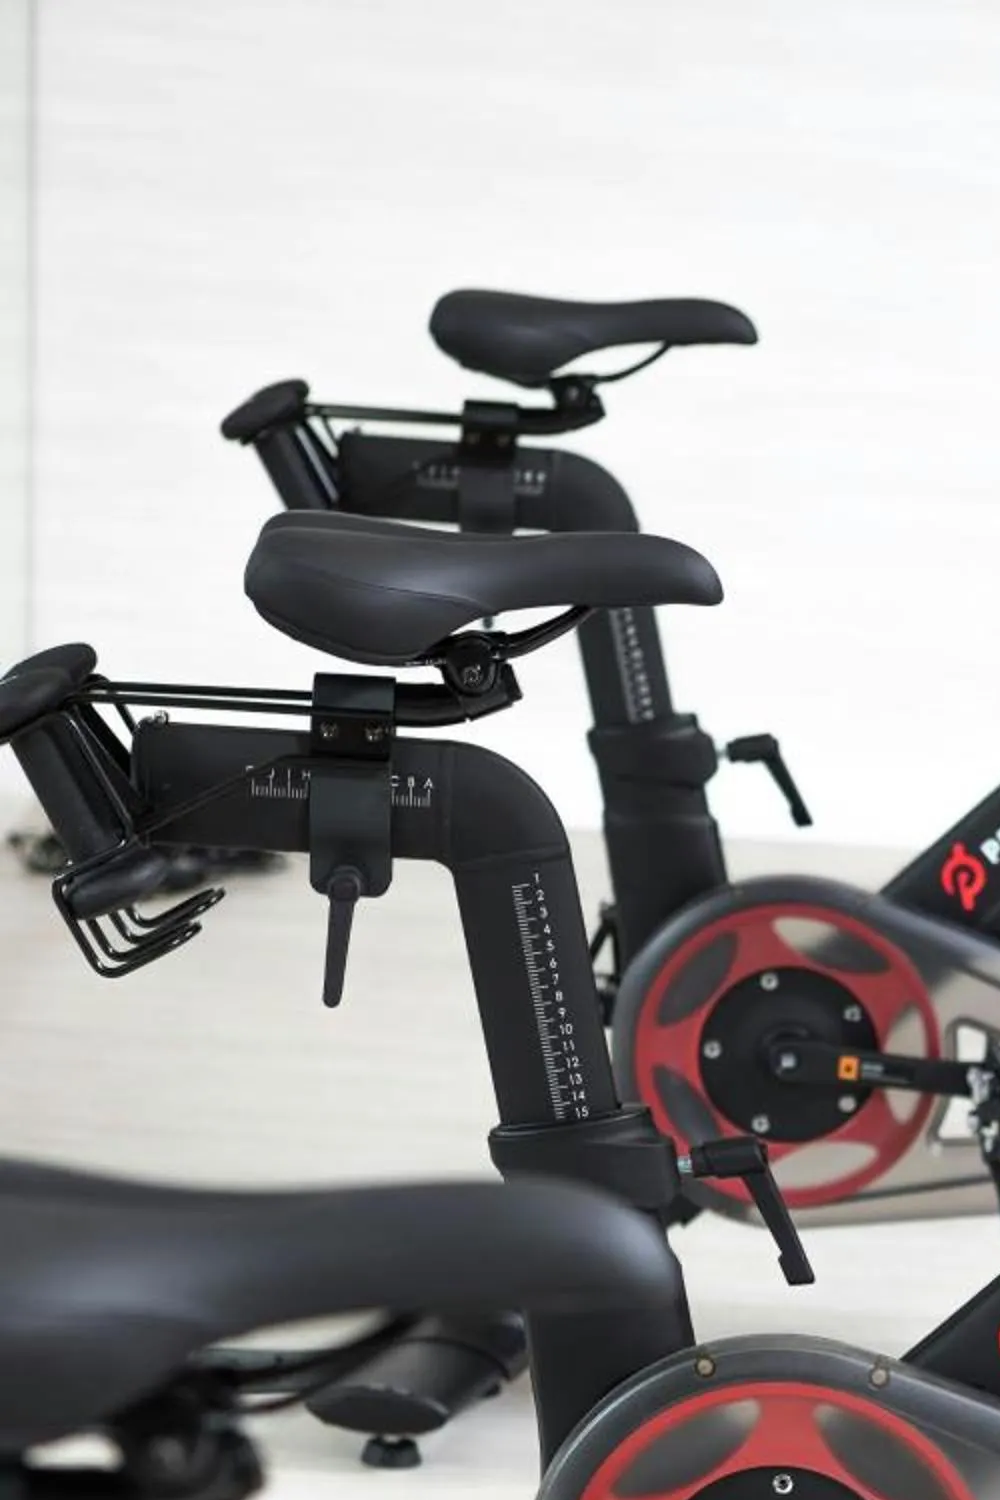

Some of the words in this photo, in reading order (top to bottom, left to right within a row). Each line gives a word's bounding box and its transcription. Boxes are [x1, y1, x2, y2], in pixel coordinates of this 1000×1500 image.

[558, 1023, 574, 1035] 10
[565, 1055, 581, 1069] 12
[568, 1072, 583, 1086] 13
[571, 1089, 587, 1102] 14
[574, 1105, 590, 1119] 15
